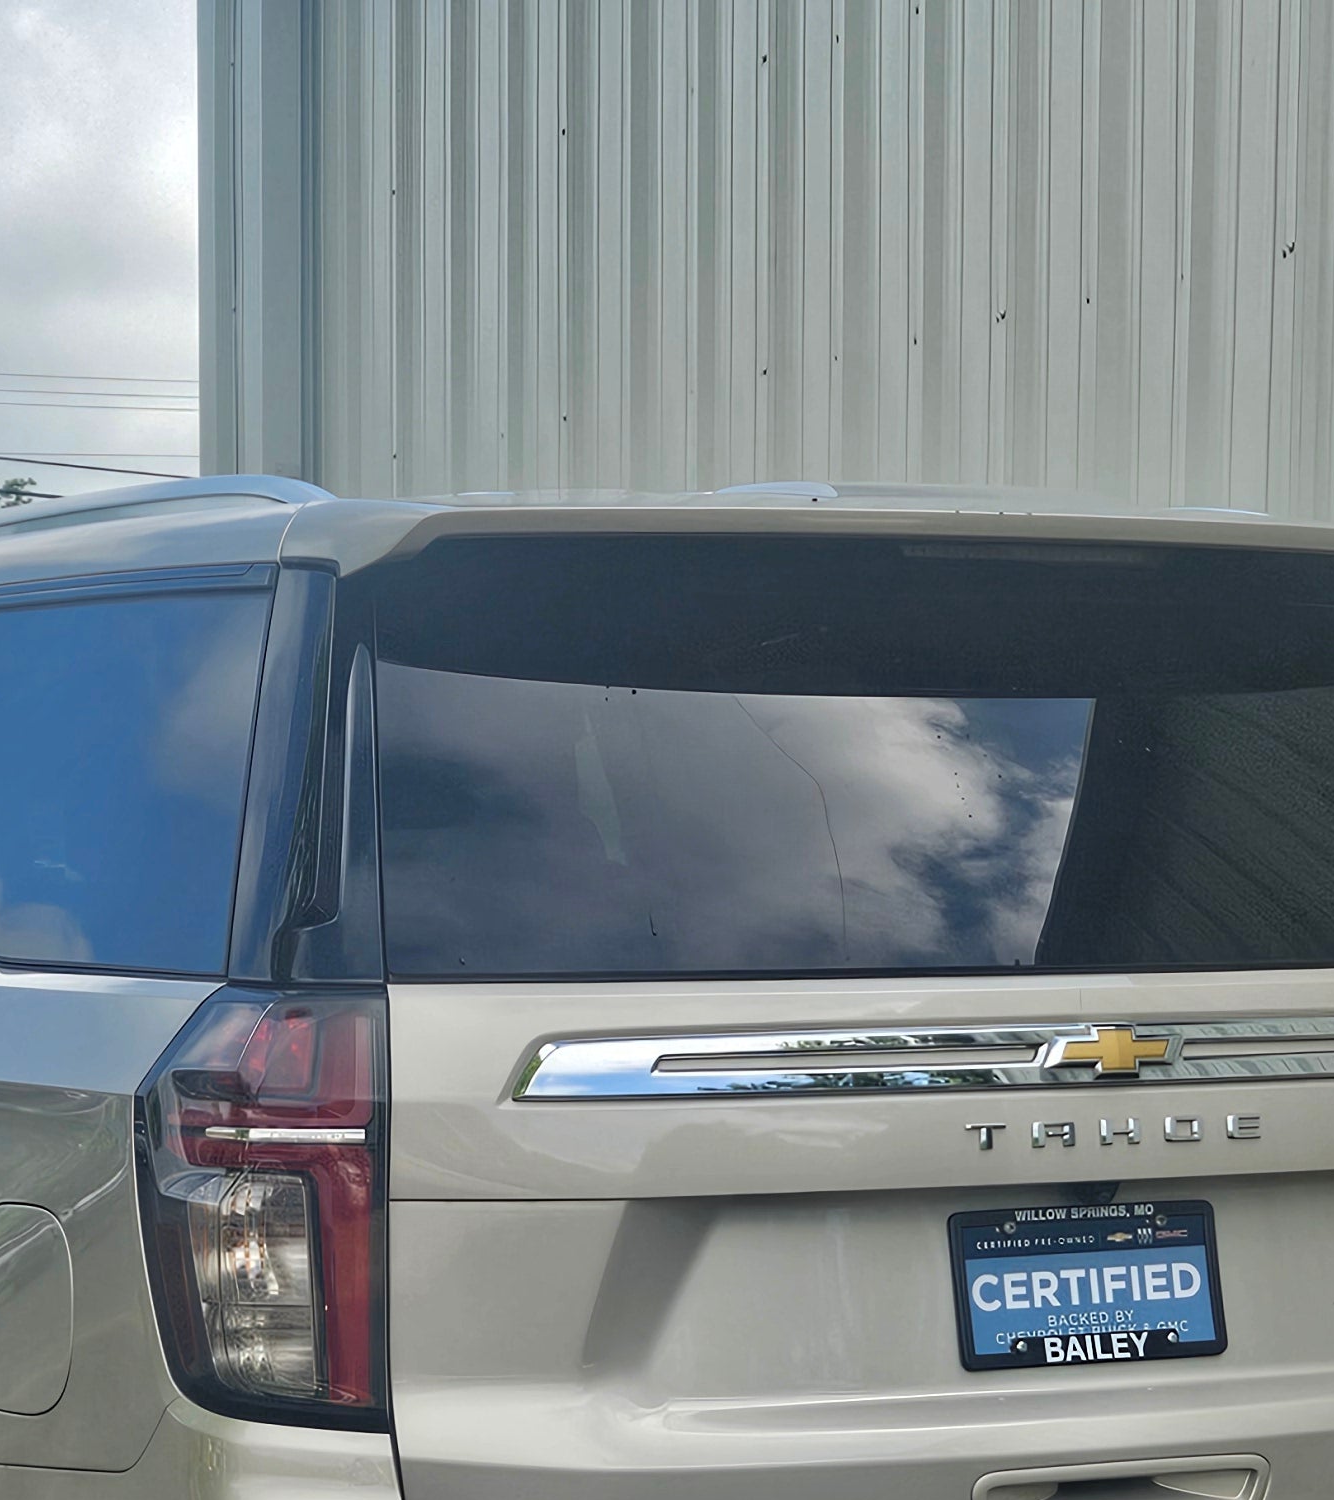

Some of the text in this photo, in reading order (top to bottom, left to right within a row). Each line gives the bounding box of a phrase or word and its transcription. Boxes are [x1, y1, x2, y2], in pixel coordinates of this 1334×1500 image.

[965, 1113, 1262, 1151] TAHOE
[1015, 1203, 1154, 1222] WILLOW SPRINGS, MO
[971, 1262, 1201, 1312] CERTIFIED
[1047, 1310, 1134, 1327] BACKED BY
[1044, 1331, 1148, 1363] BAILEY
